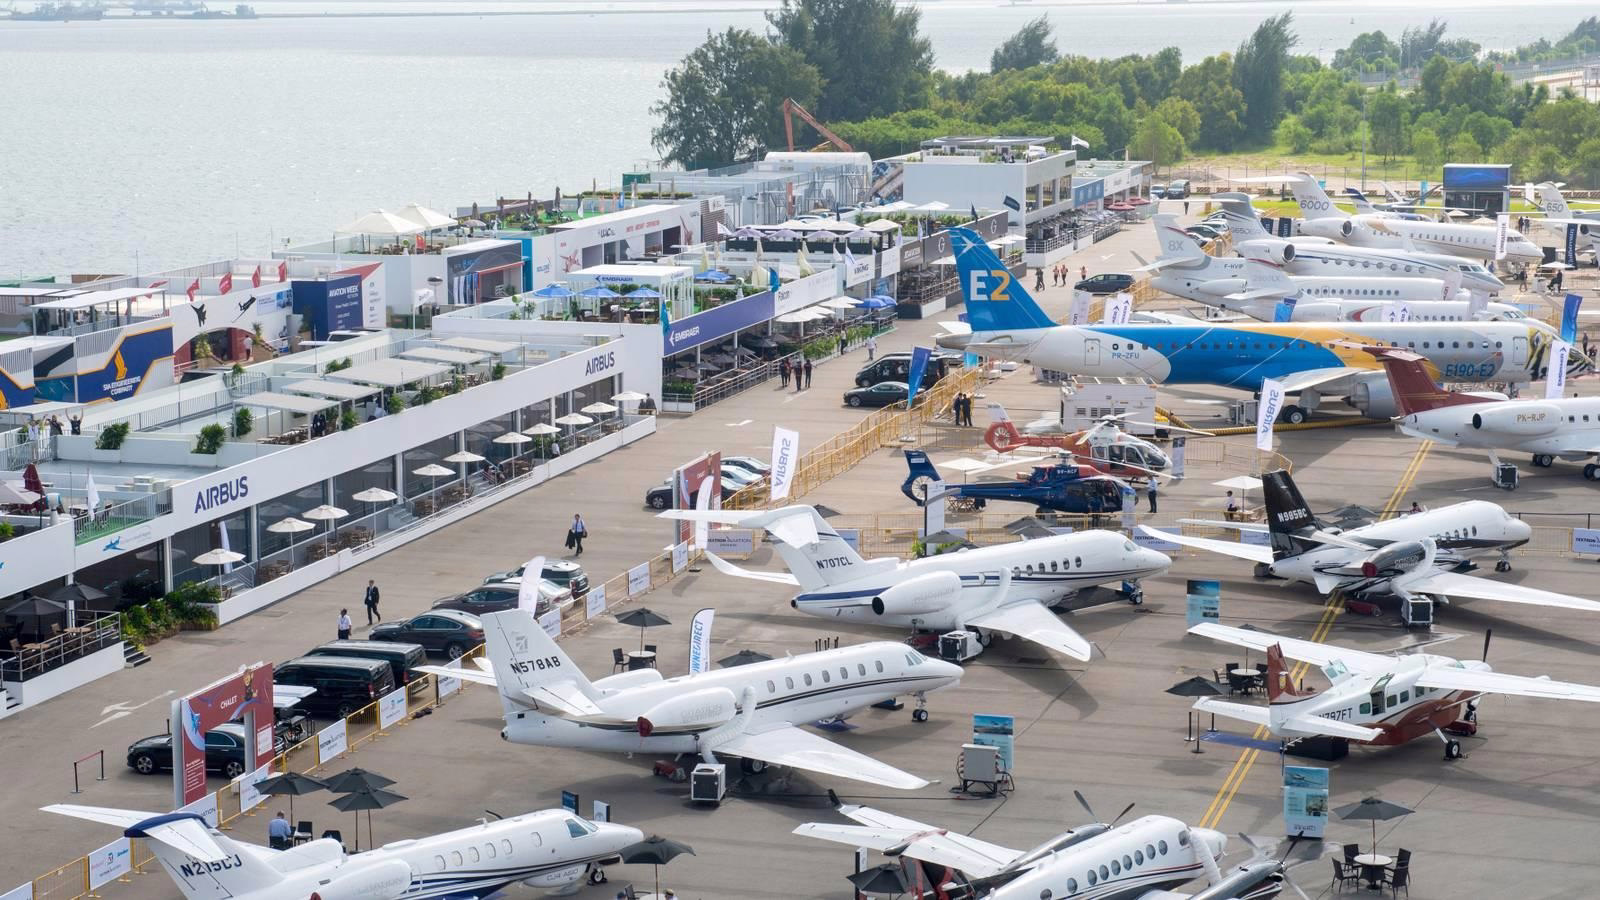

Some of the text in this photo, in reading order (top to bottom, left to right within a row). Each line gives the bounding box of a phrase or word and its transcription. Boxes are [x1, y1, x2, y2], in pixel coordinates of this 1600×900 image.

[1300, 200, 1330, 211] 6000
[1546, 202, 1564, 213] 650
[1168, 240, 1184, 252] 8X
[970, 270, 1010, 301] E2
[674, 326, 700, 342] EMBRAER
[1112, 352, 1140, 360] PR-ZFU
[585, 351, 616, 376] AIRBUS
[1445, 363, 1496, 377] E190-E2
[111, 375, 141, 389] ENGINEERING
[1516, 413, 1546, 423] PK-RJP
[194, 475, 249, 514] AIRBUS
[1277, 507, 1308, 523] N985BC
[816, 555, 854, 569] N707CL
[510, 655, 562, 674] N578AB
[220, 695, 239, 710] CHALET
